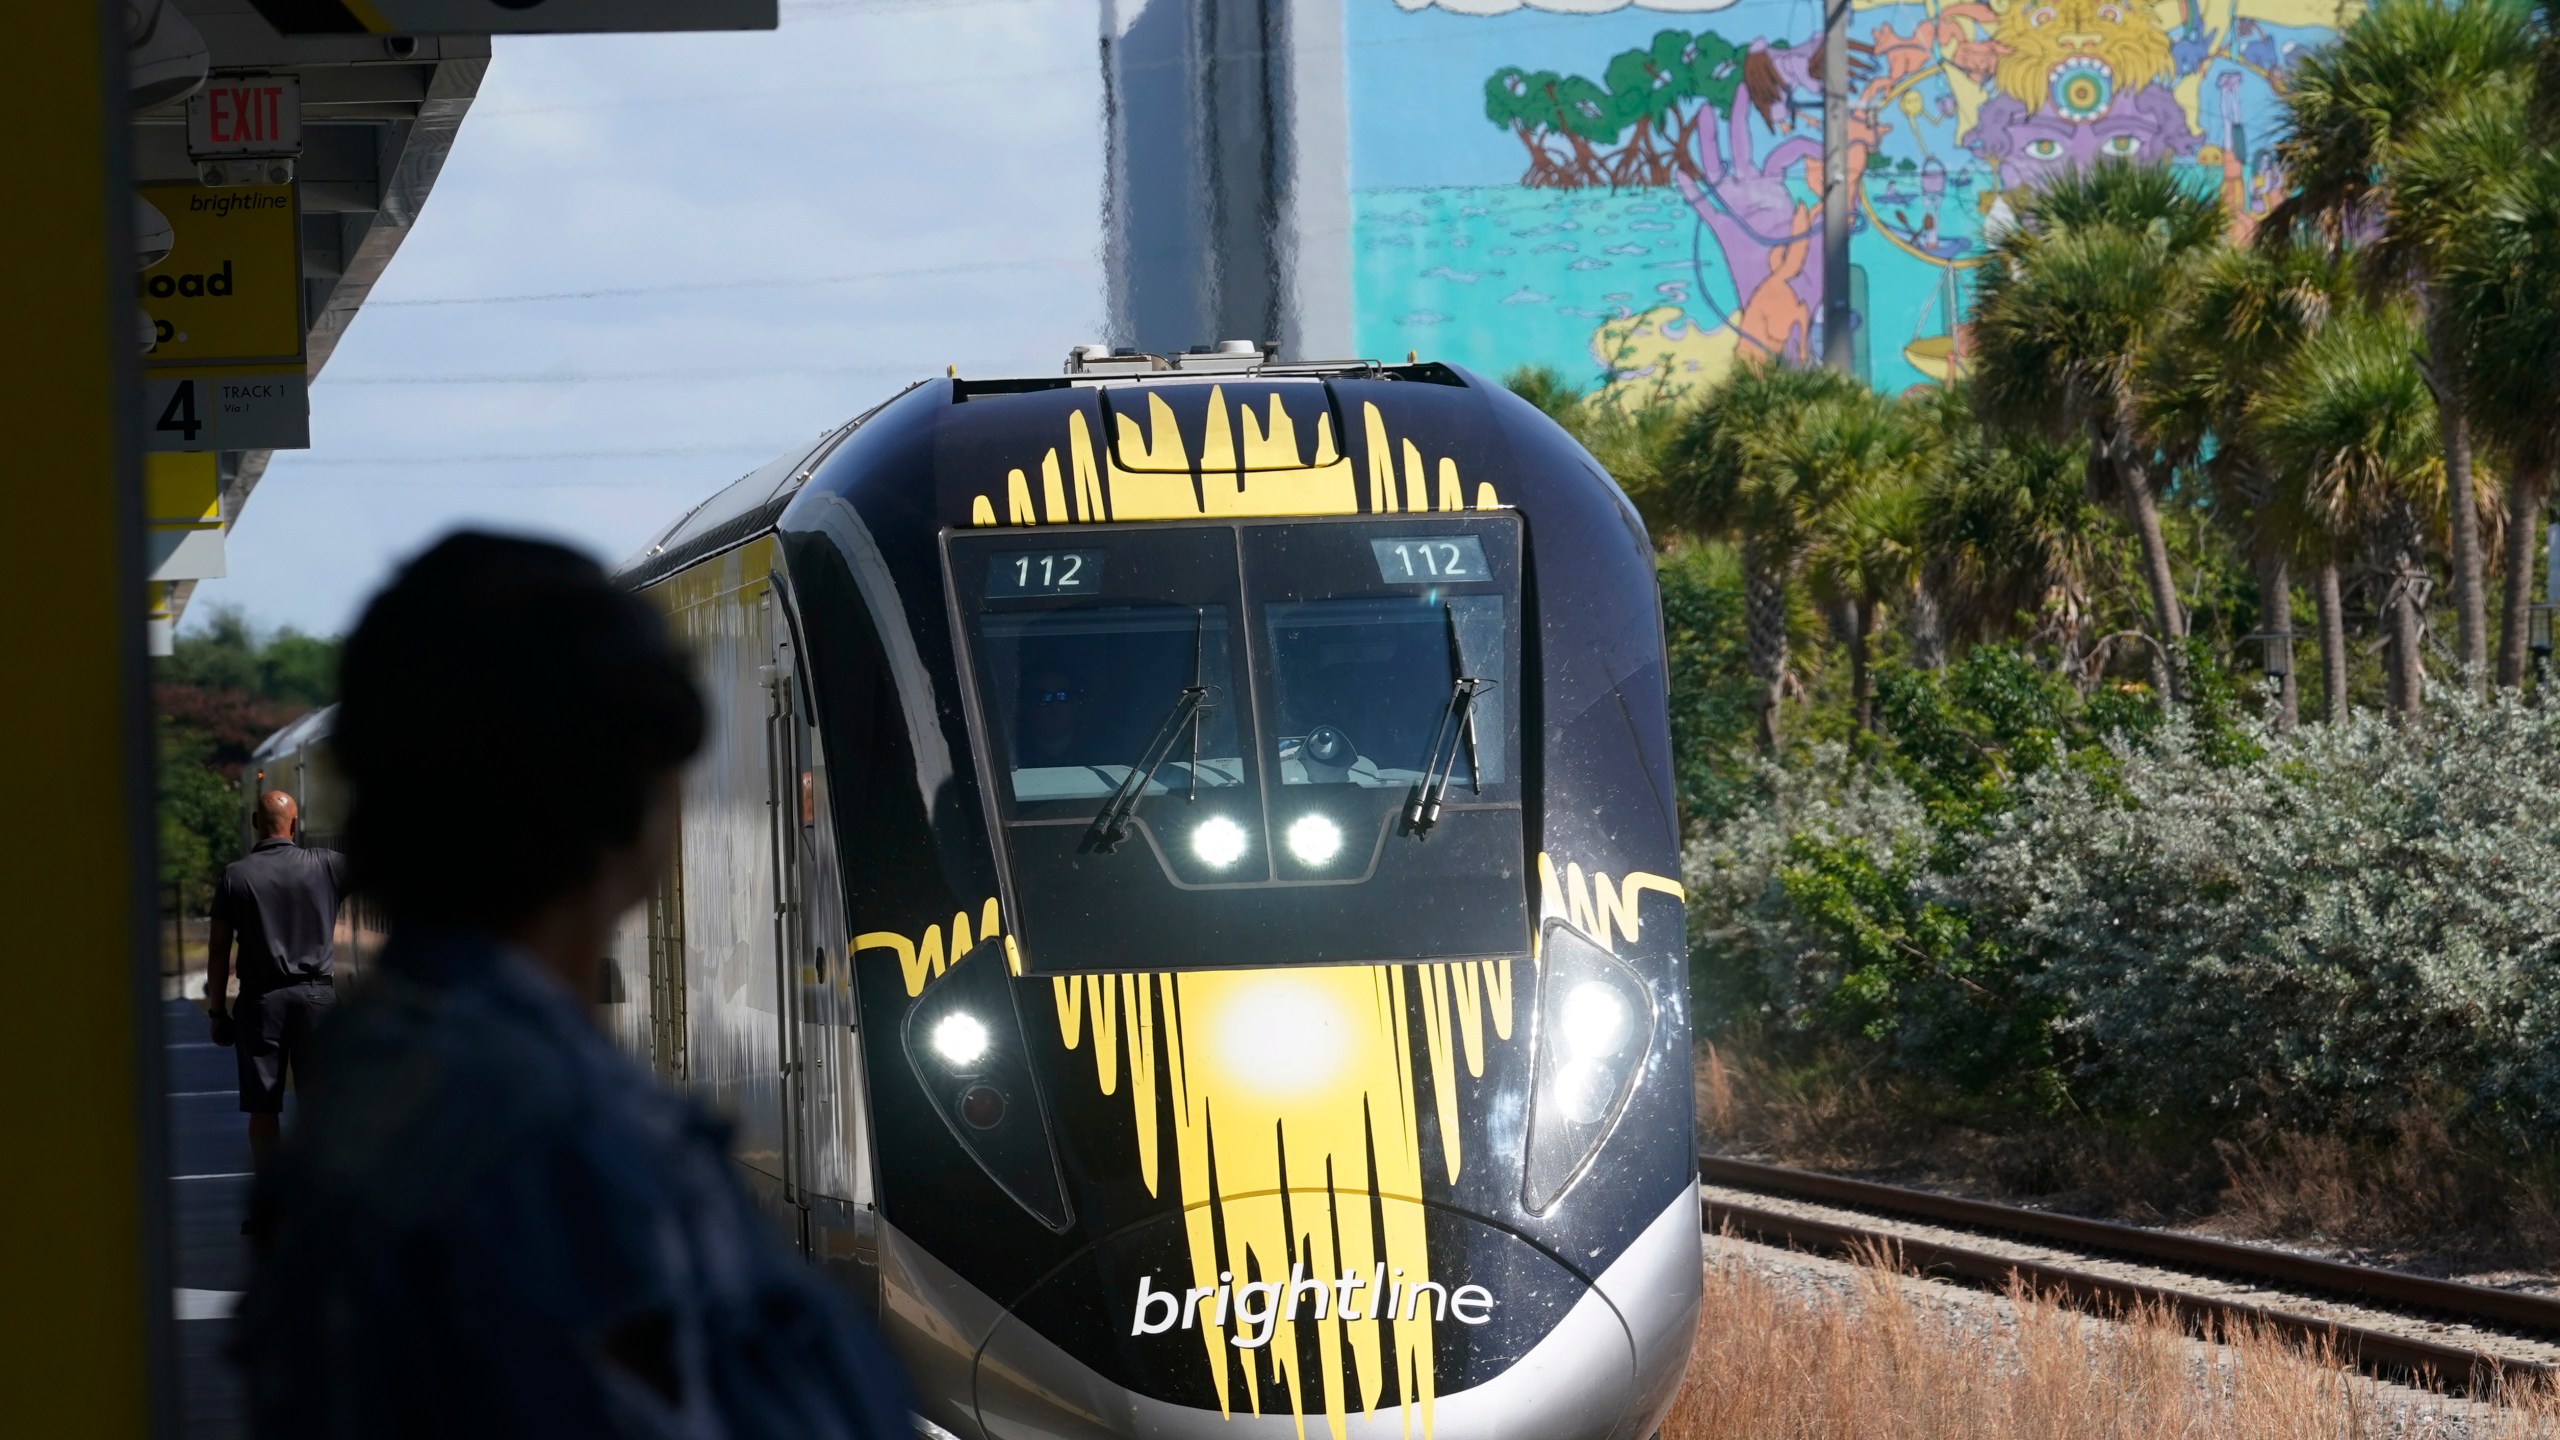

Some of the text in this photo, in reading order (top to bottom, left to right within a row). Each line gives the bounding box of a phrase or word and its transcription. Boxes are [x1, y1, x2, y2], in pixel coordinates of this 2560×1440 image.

[210, 87, 282, 142] EXIT
[190, 192, 288, 217] brightline
[140, 256, 233, 298] oad
[223, 384, 285, 398] TRACK 1
[156, 380, 202, 441] 4
[1015, 553, 1083, 588] 112
[1394, 542, 1467, 577] 112
[1131, 1261, 1496, 1349] brightline
